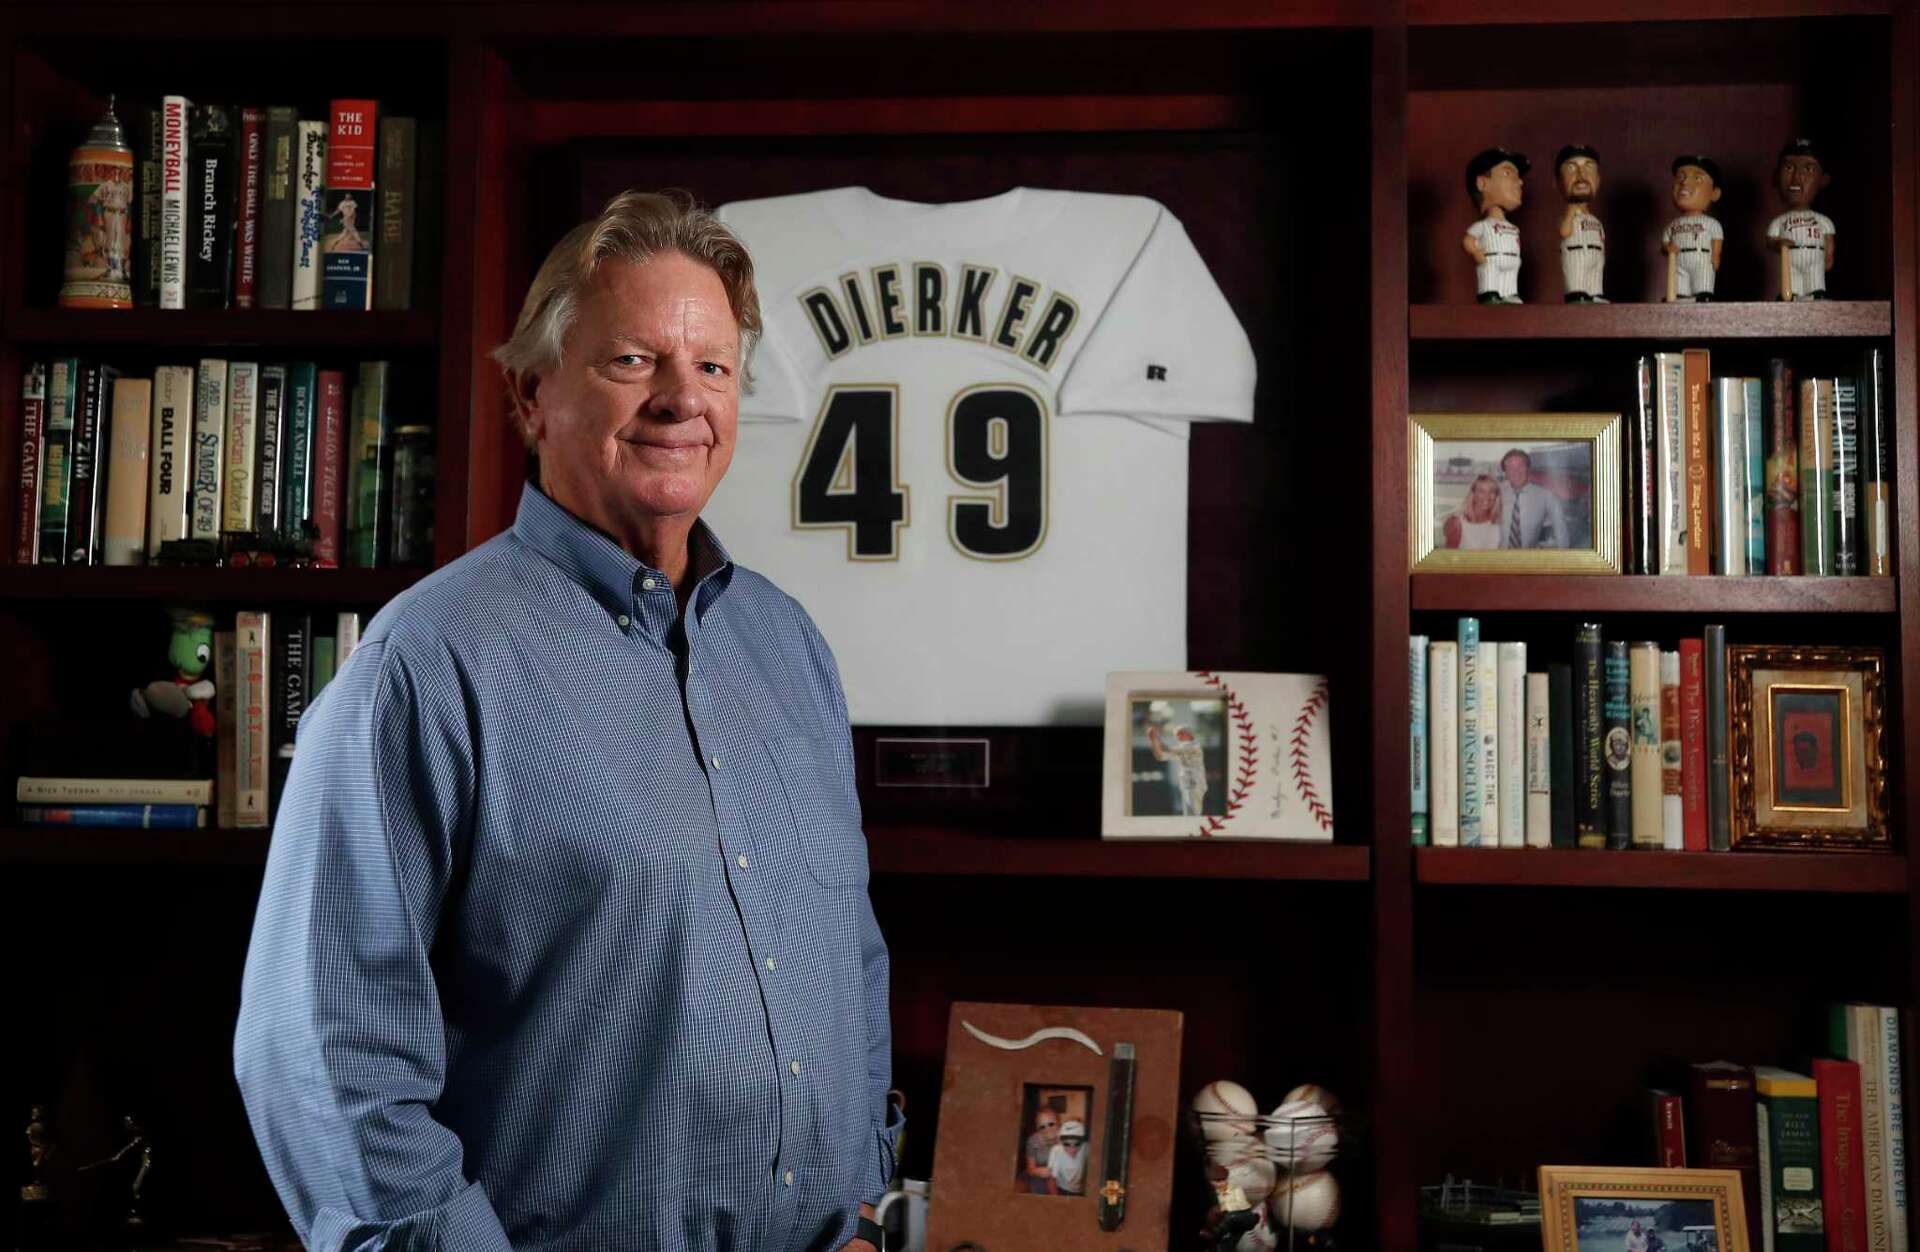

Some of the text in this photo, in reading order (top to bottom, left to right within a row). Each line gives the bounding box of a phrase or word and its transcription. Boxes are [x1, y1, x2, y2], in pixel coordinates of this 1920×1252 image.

[337, 124, 362, 136] KID
[338, 112, 363, 123] THE
[164, 103, 182, 193] MONEYBALL
[302, 130, 317, 191] Durocher
[199, 158, 218, 263] Branch Rickey
[242, 132, 259, 285] ONLY THE BALL WAS WHITE
[163, 200, 181, 285] MICHAEL LEWIS
[797, 262, 1079, 371] DIERKER
[234, 368, 252, 399] David
[265, 388, 278, 405] THE
[21, 401, 38, 488] THE GAME
[75, 440, 92, 480] ZIM
[160, 407, 174, 495] BALL FOUR
[262, 459, 274, 480] THE
[263, 444, 275, 458] OF
[292, 428, 305, 480] ANGELL
[791, 383, 1049, 561] 49
[198, 497, 213, 513] OF
[322, 464, 336, 520] TICKET
[286, 630, 303, 729] THE GAME
[1463, 654, 1476, 712] KINSELLA
[1587, 658, 1601, 809] The Heavenly World Series
[1463, 718, 1479, 815] BOX SOCIALS
[1485, 783, 1496, 807] TIME
[1835, 1094, 1851, 1121] The
[1866, 1080, 1878, 1105] THE
[1886, 1016, 1907, 1209] DIAMONDS ARE FOREVER
[1866, 1111, 1882, 1184] AMERICAN
